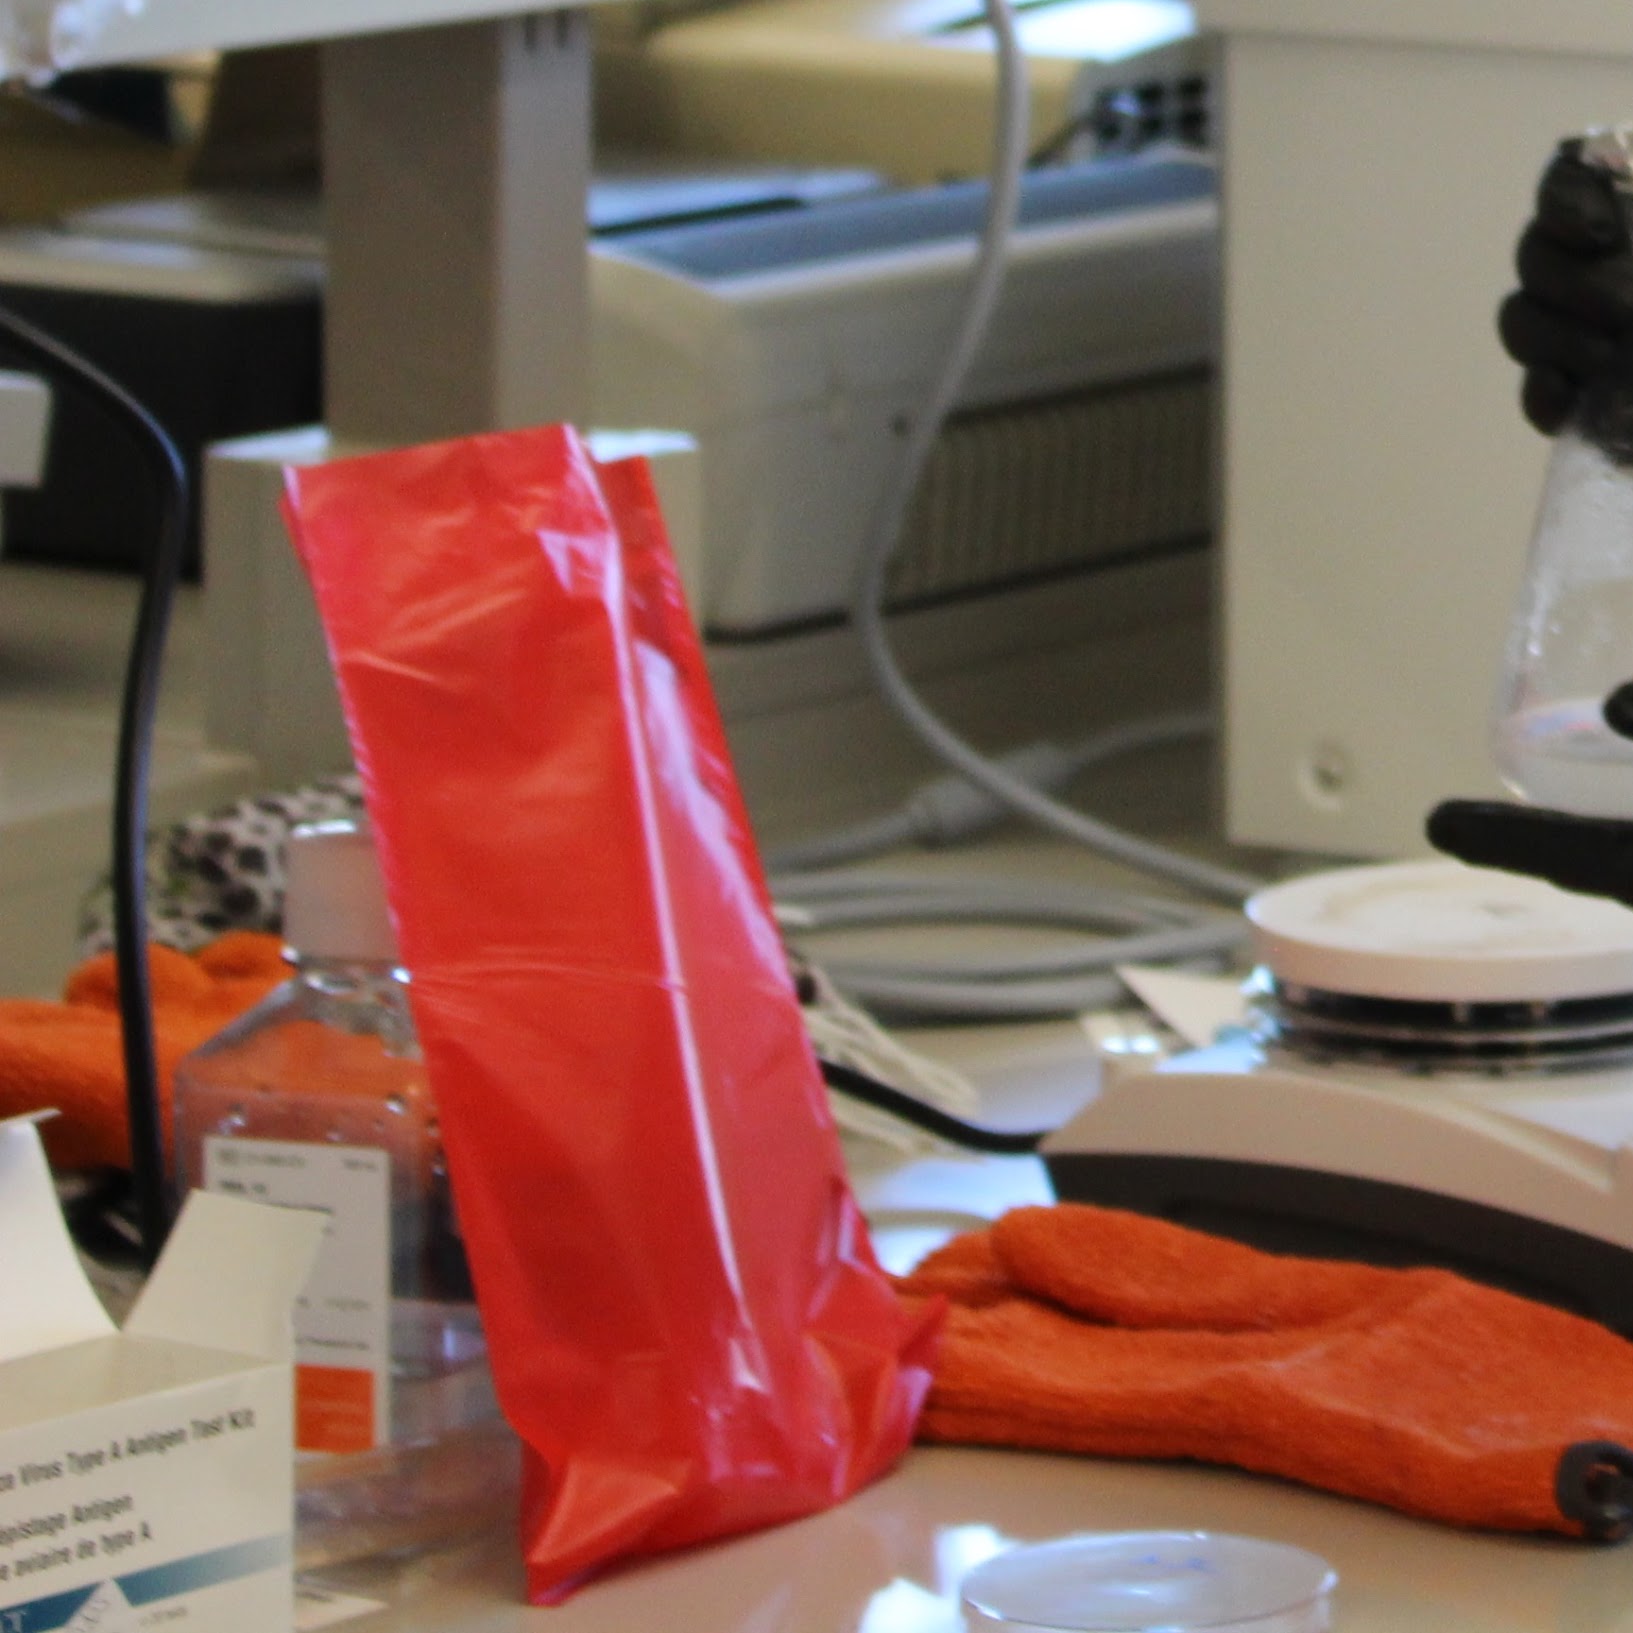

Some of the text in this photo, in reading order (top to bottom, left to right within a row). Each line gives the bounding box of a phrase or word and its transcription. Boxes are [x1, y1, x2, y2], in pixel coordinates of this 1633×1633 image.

[66, 1449, 105, 1475] Type
[110, 1440, 122, 1460] A
[126, 1428, 188, 1456] Antigen
[191, 1416, 224, 1439] Test
[228, 1408, 255, 1430] Kit
[71, 1494, 134, 1523] Antigen
[77, 1539, 97, 1560] de
[102, 1529, 135, 1555] type
[140, 1520, 152, 1541] A
